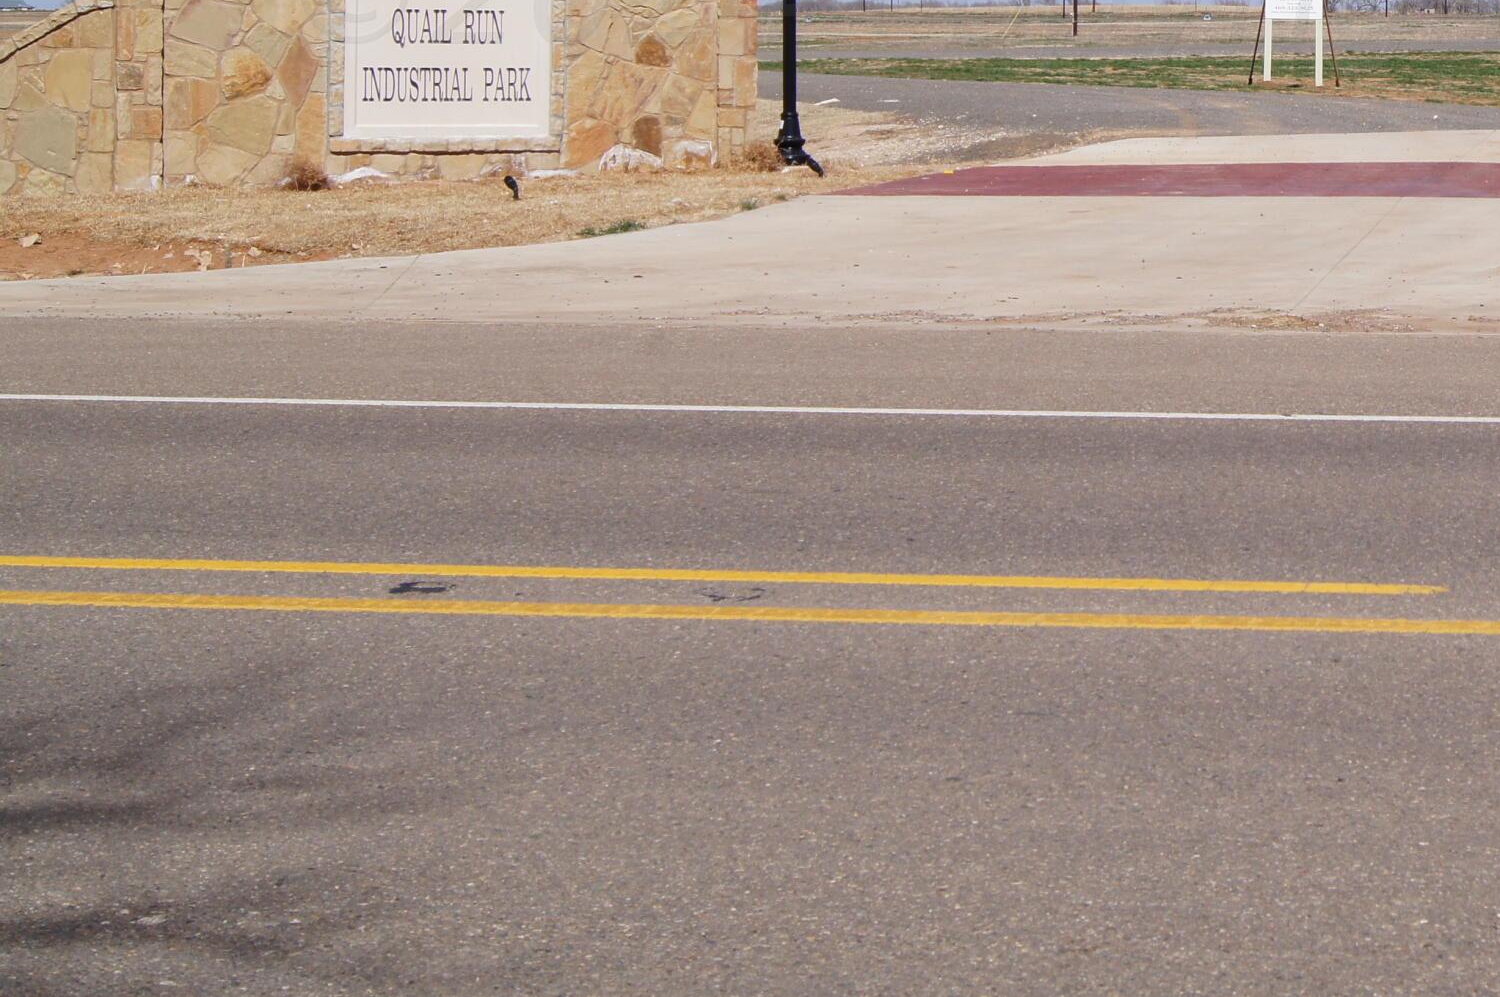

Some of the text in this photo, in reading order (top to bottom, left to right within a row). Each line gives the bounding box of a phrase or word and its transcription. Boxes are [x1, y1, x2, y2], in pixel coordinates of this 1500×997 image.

[391, 8, 505, 48] QUAIL RUN
[362, 67, 531, 102] INDUSTRIAL PARK
